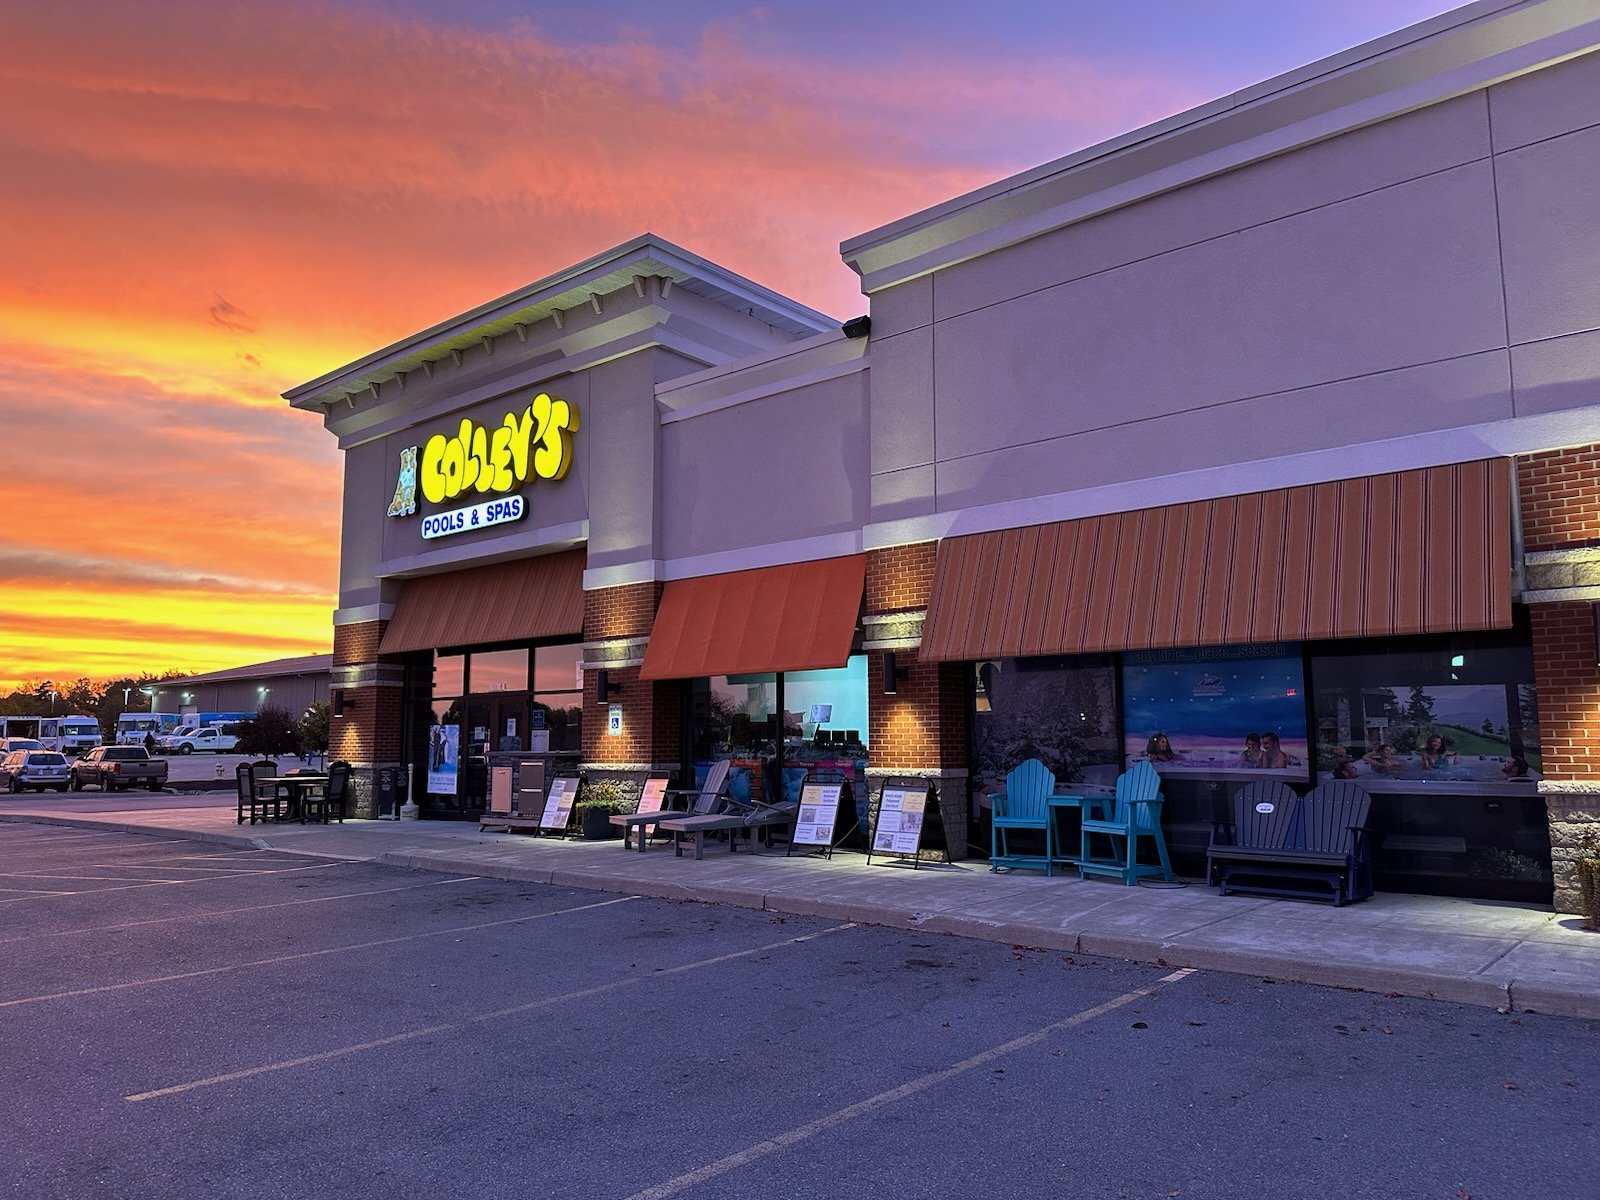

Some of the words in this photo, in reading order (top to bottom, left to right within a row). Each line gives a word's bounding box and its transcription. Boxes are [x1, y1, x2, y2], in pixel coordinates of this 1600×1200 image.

[421, 392, 572, 504] COLLEY'S
[424, 512, 464, 536] POOLS
[471, 508, 479, 526] &
[486, 498, 520, 522] SPAS
